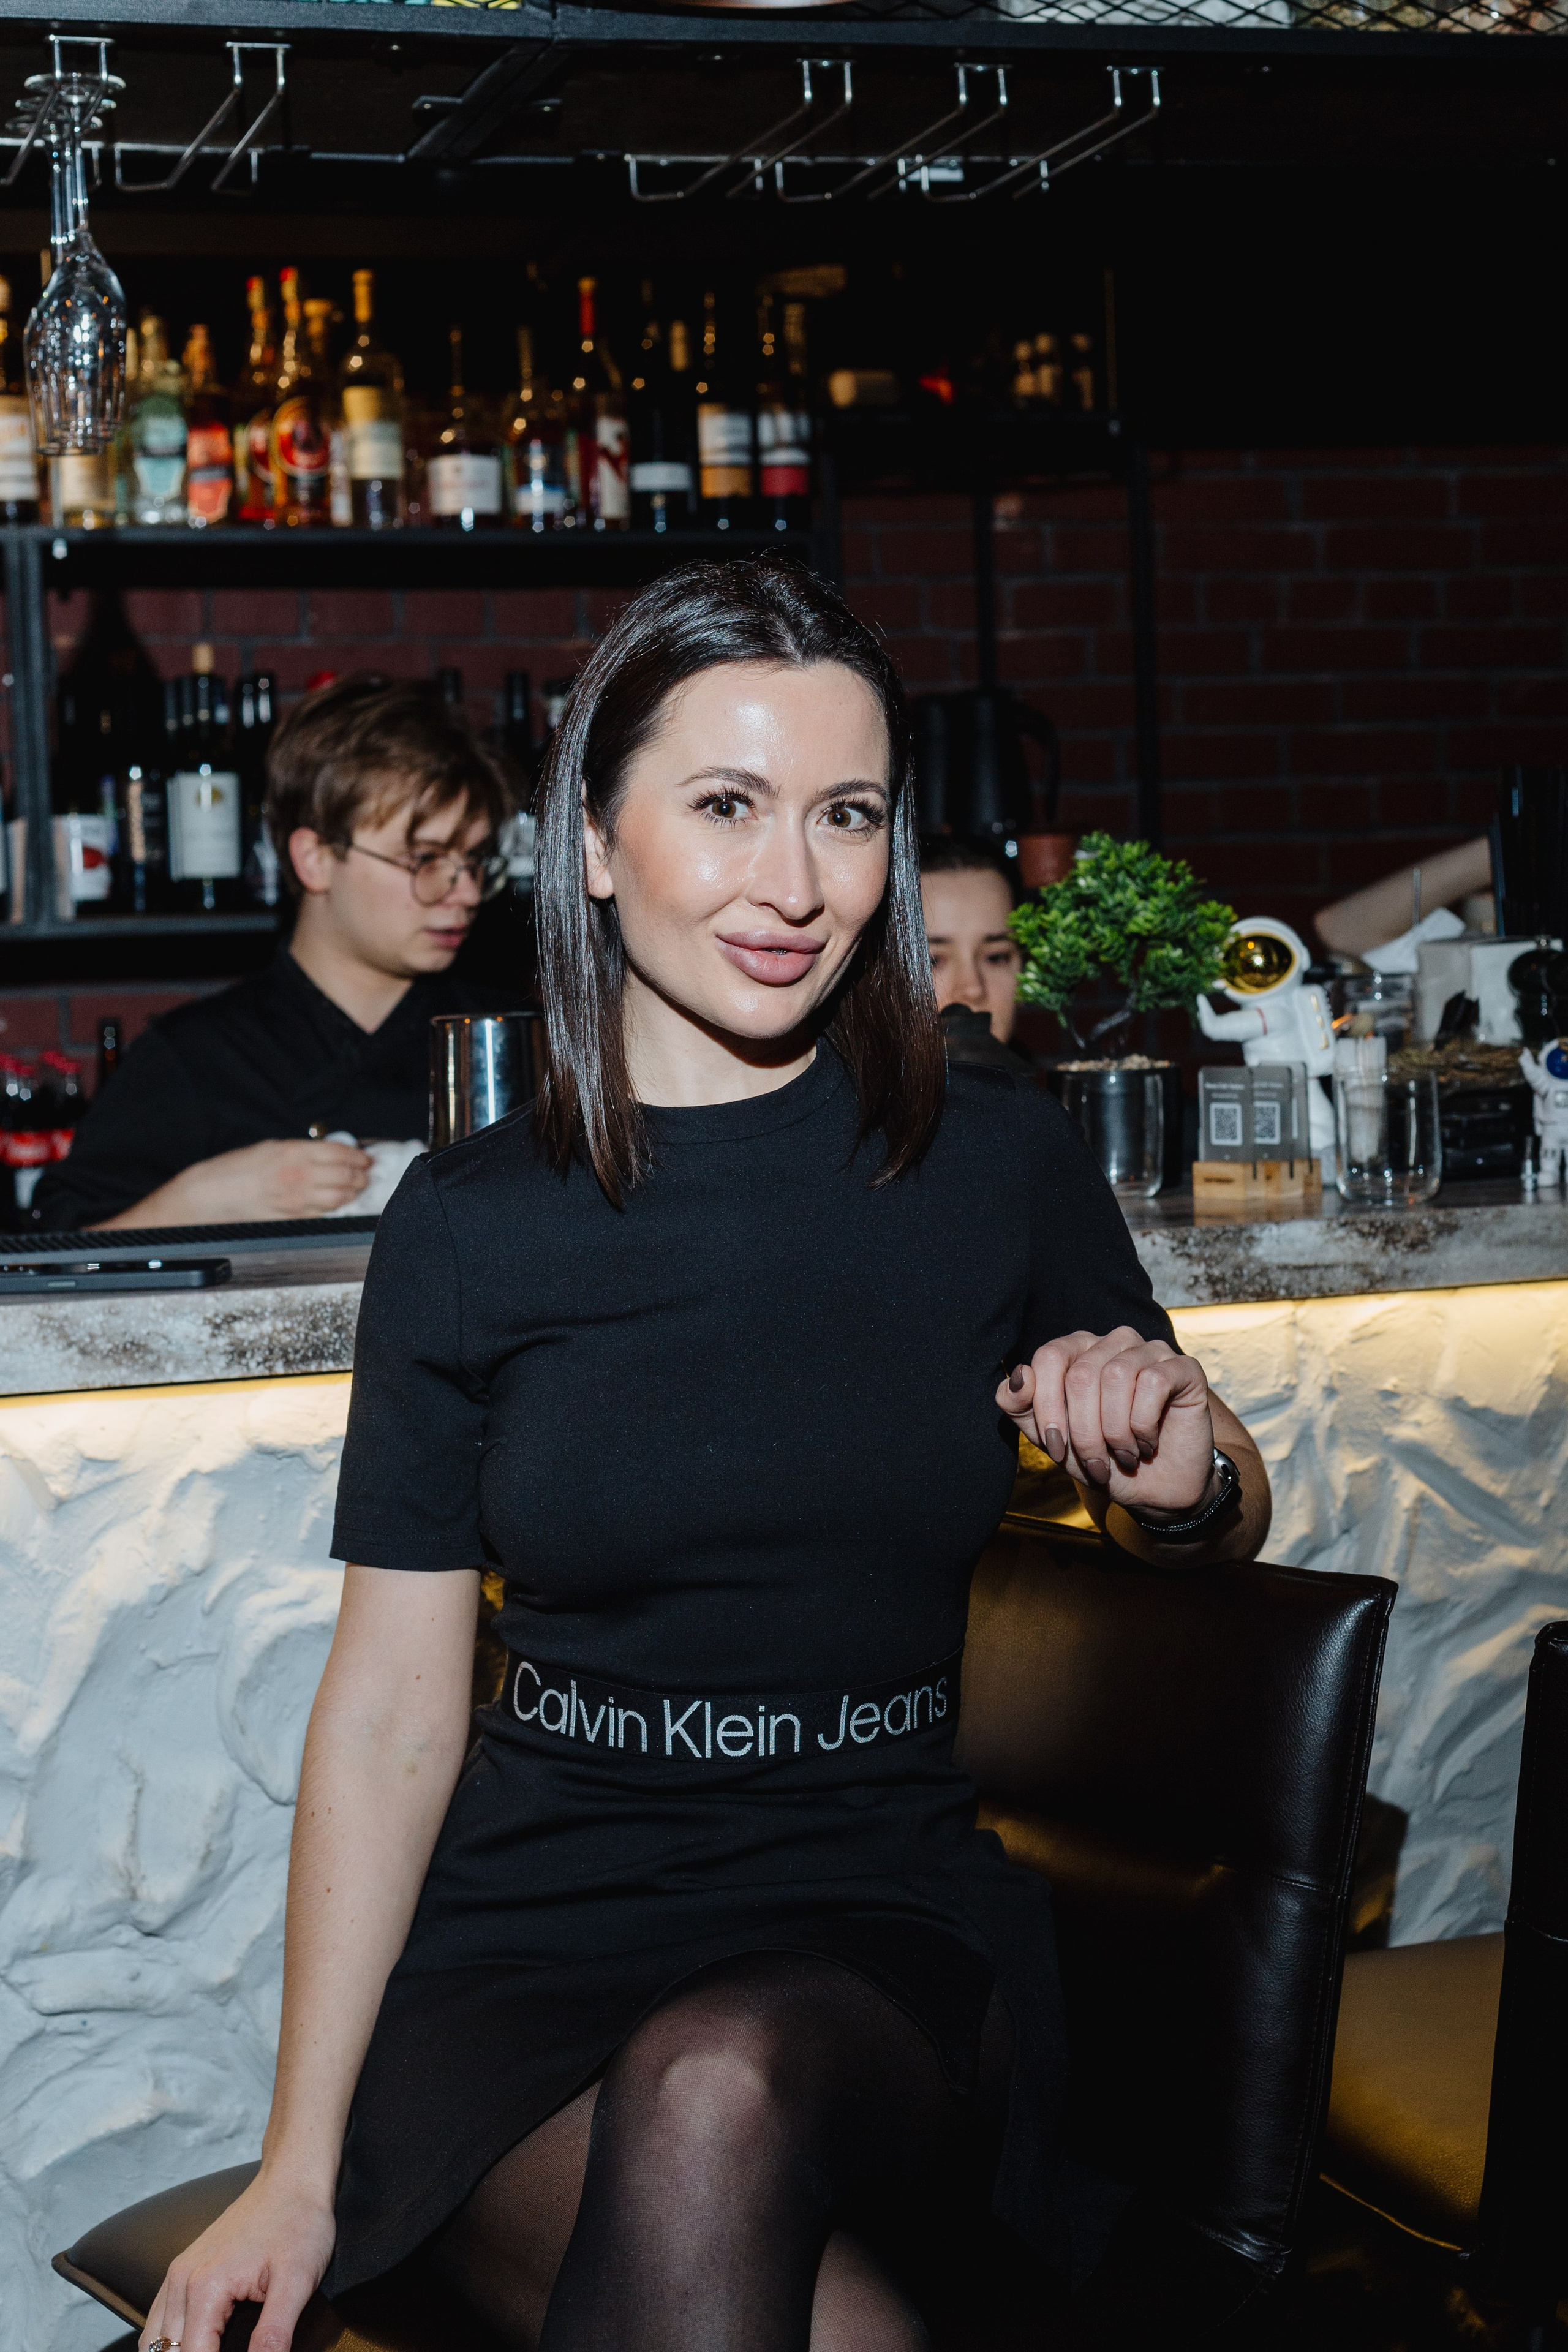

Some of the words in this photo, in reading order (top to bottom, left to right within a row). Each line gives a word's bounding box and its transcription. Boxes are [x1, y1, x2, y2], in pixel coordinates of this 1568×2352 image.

[513, 1660, 648, 1752] Calvin
[663, 1699, 801, 1758] Klein
[816, 1676, 947, 1751] Jeans
